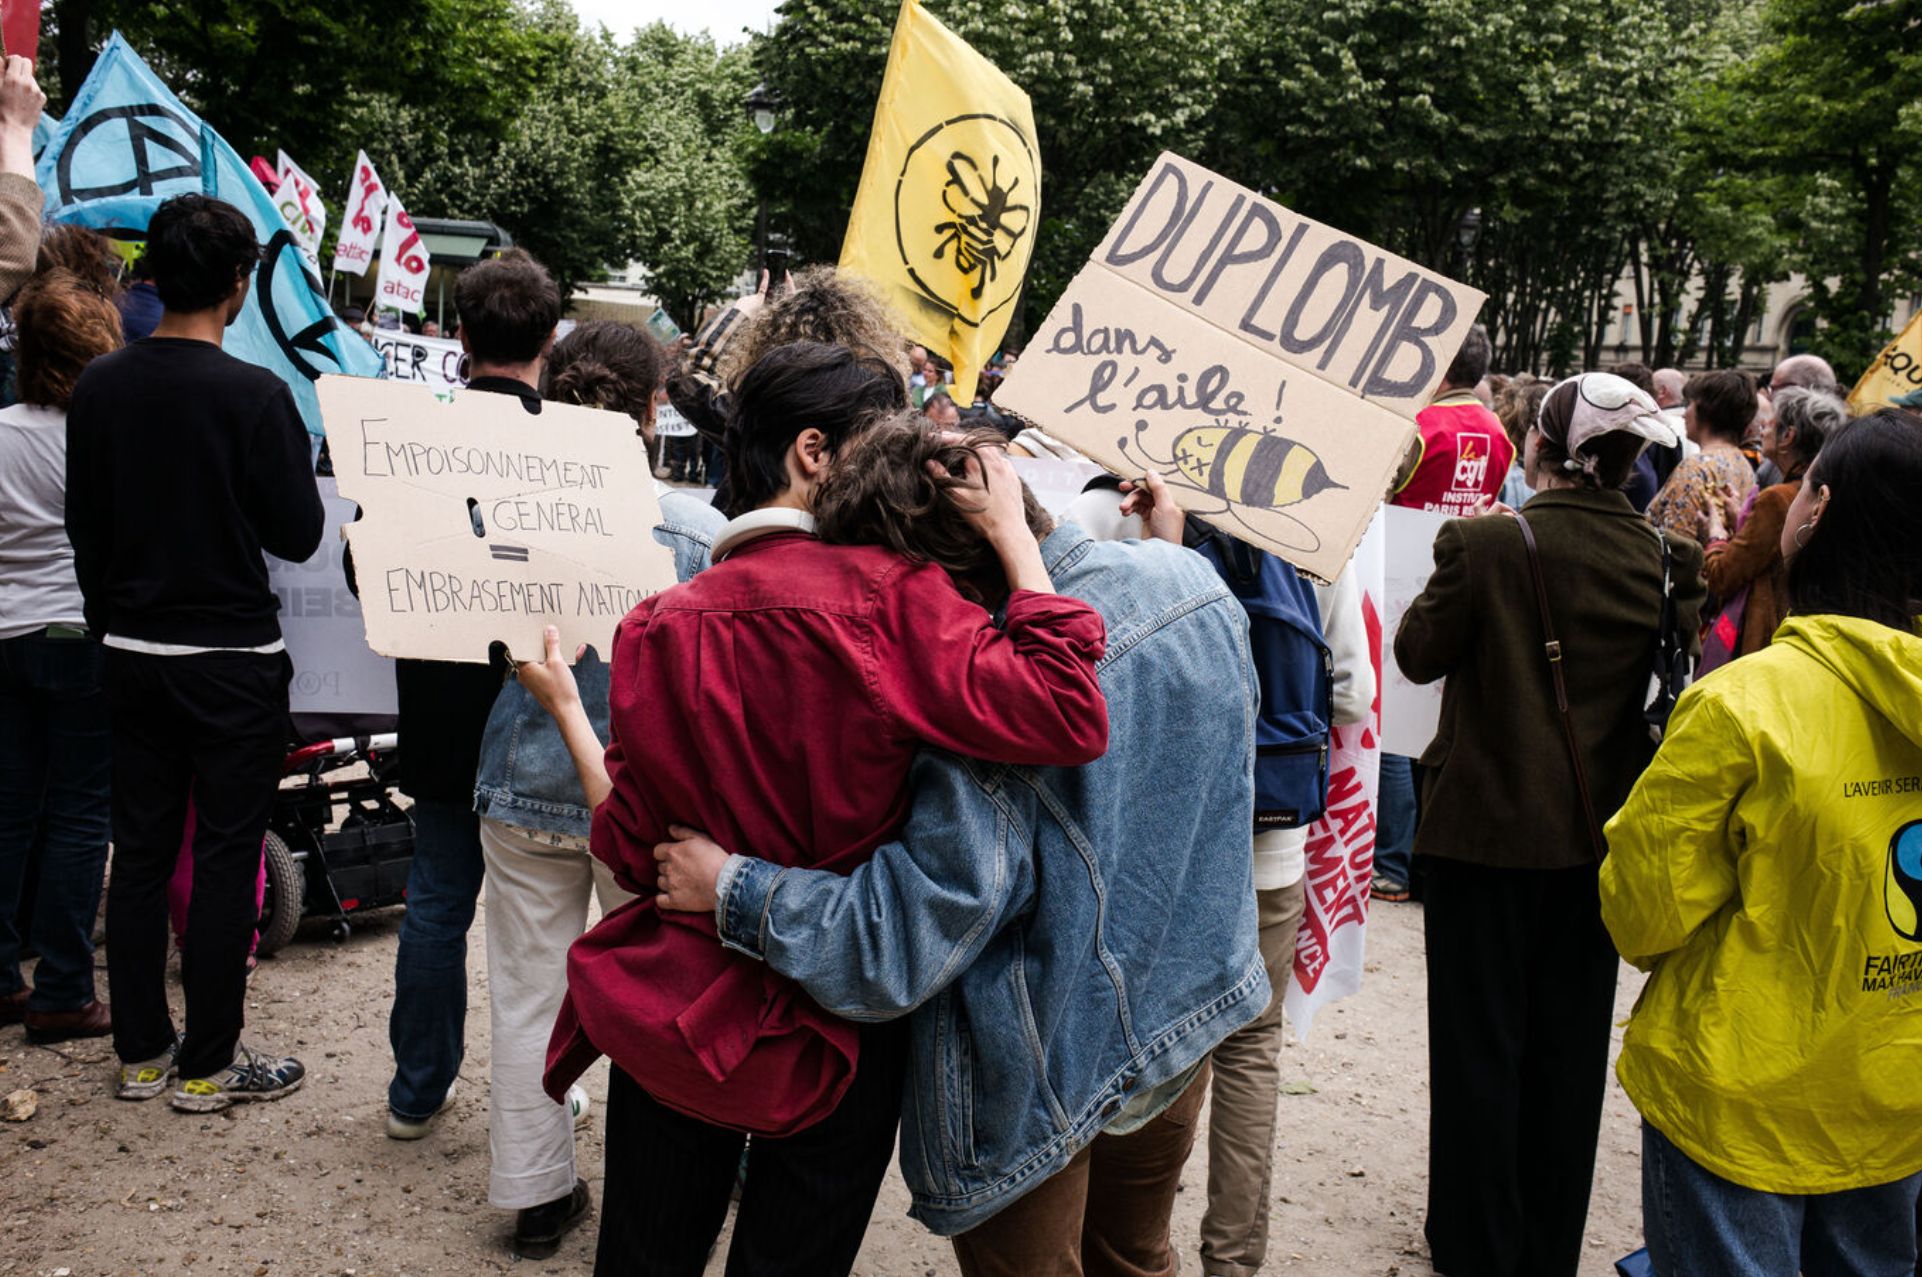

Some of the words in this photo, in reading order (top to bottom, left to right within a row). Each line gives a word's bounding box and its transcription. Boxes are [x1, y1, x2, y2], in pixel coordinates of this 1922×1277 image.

[1105, 162, 1458, 399] DUPLOMB
[1045, 302, 1177, 364] dans
[1062, 360, 1253, 418] l'aile
[1455, 455, 1488, 487] cgt
[386, 568, 564, 616] EMBRASEMENT
[1895, 775, 1922, 793] SER
[1862, 973, 1896, 993] MAX
[1864, 950, 1922, 977] FAIRT
